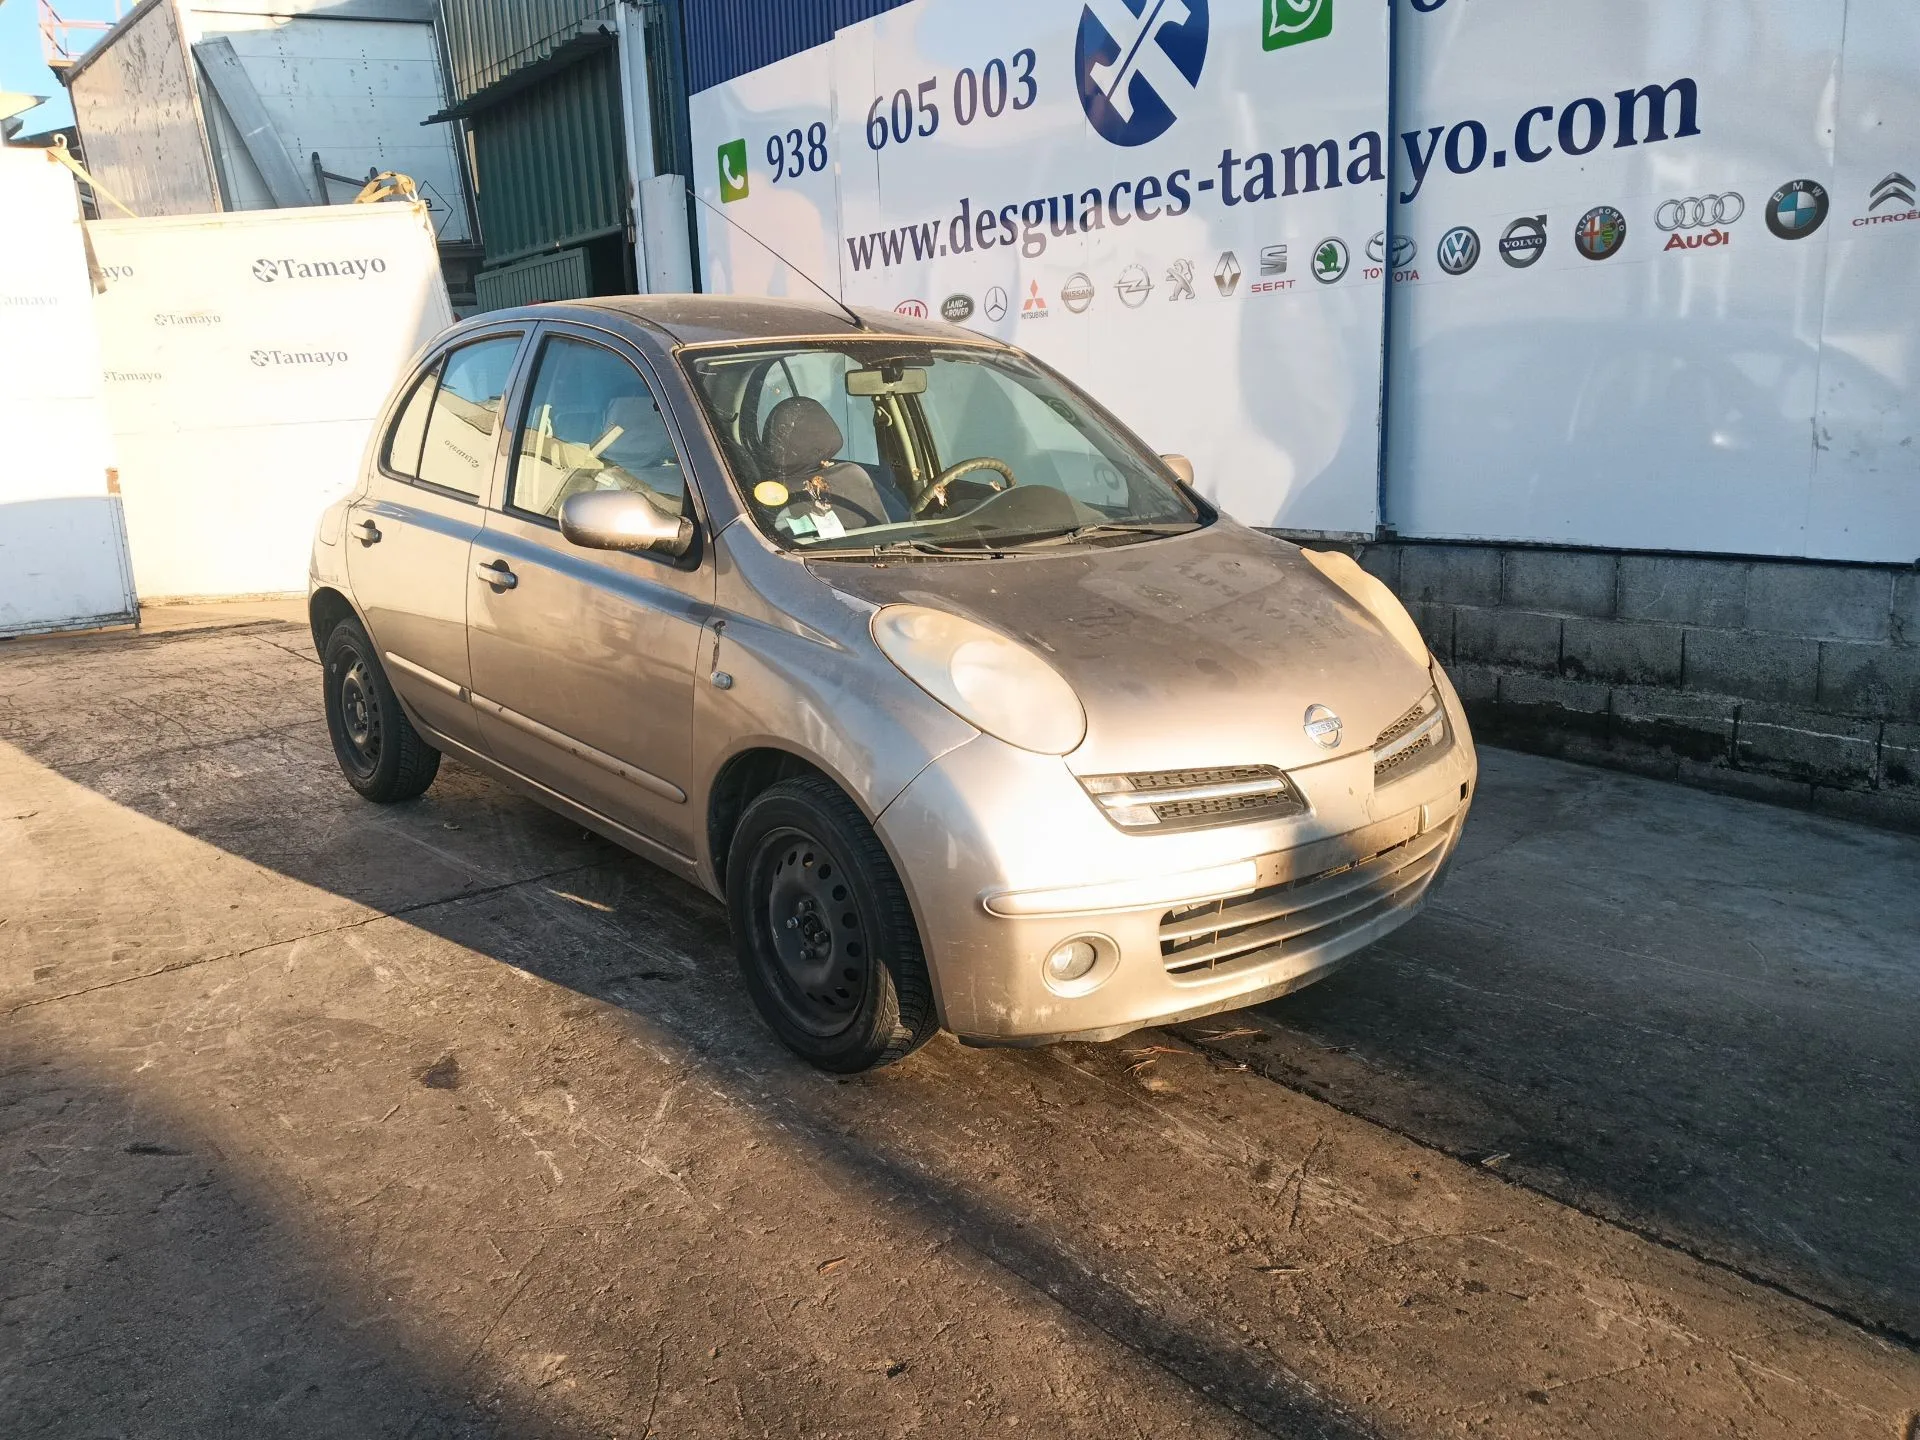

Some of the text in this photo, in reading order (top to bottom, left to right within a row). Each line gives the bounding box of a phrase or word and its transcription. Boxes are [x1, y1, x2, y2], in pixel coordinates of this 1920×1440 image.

[766, 47, 1038, 183] 938 605 003
[847, 77, 1701, 272] www.desguaces-tamayo.com
[1503, 237, 1543, 249] VOLVO
[1663, 229, 1730, 252] Audi
[277, 257, 387, 281] Tamayo
[1251, 279, 1296, 293] SEAT
[1064, 289, 1093, 298] NISSAN
[946, 300, 964, 309] LAND
[948, 307, 970, 317] ROVER
[1021, 310, 1049, 320] MITSUBISHI
[166, 311, 222, 329] Tamayo
[268, 349, 349, 367] Tamayo
[110, 370, 162, 384] Tamayo
